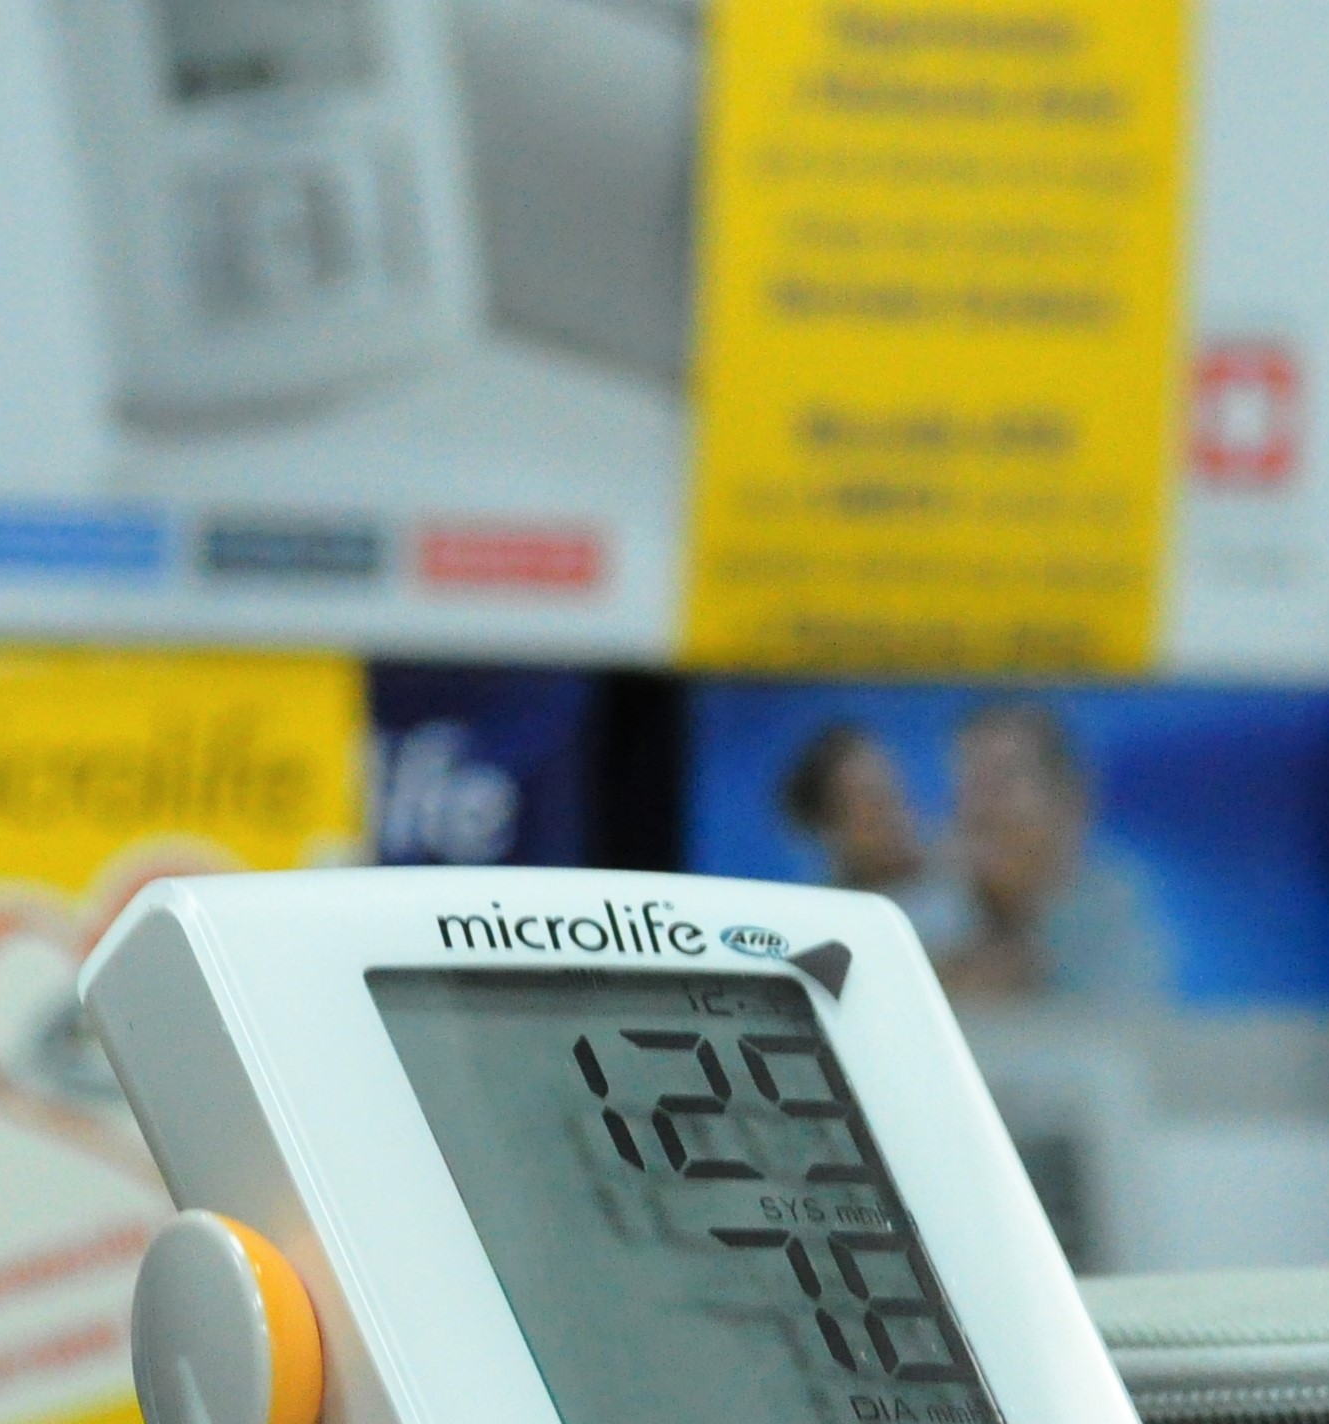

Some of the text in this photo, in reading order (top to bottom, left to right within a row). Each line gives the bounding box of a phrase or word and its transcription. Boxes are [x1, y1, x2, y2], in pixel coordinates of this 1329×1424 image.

[436, 899, 708, 955] microlife
[572, 1028, 885, 1182] 129
[759, 1195, 826, 1223] SYS
[709, 1227, 979, 1382] 78
[849, 1396, 919, 1422] DIA
